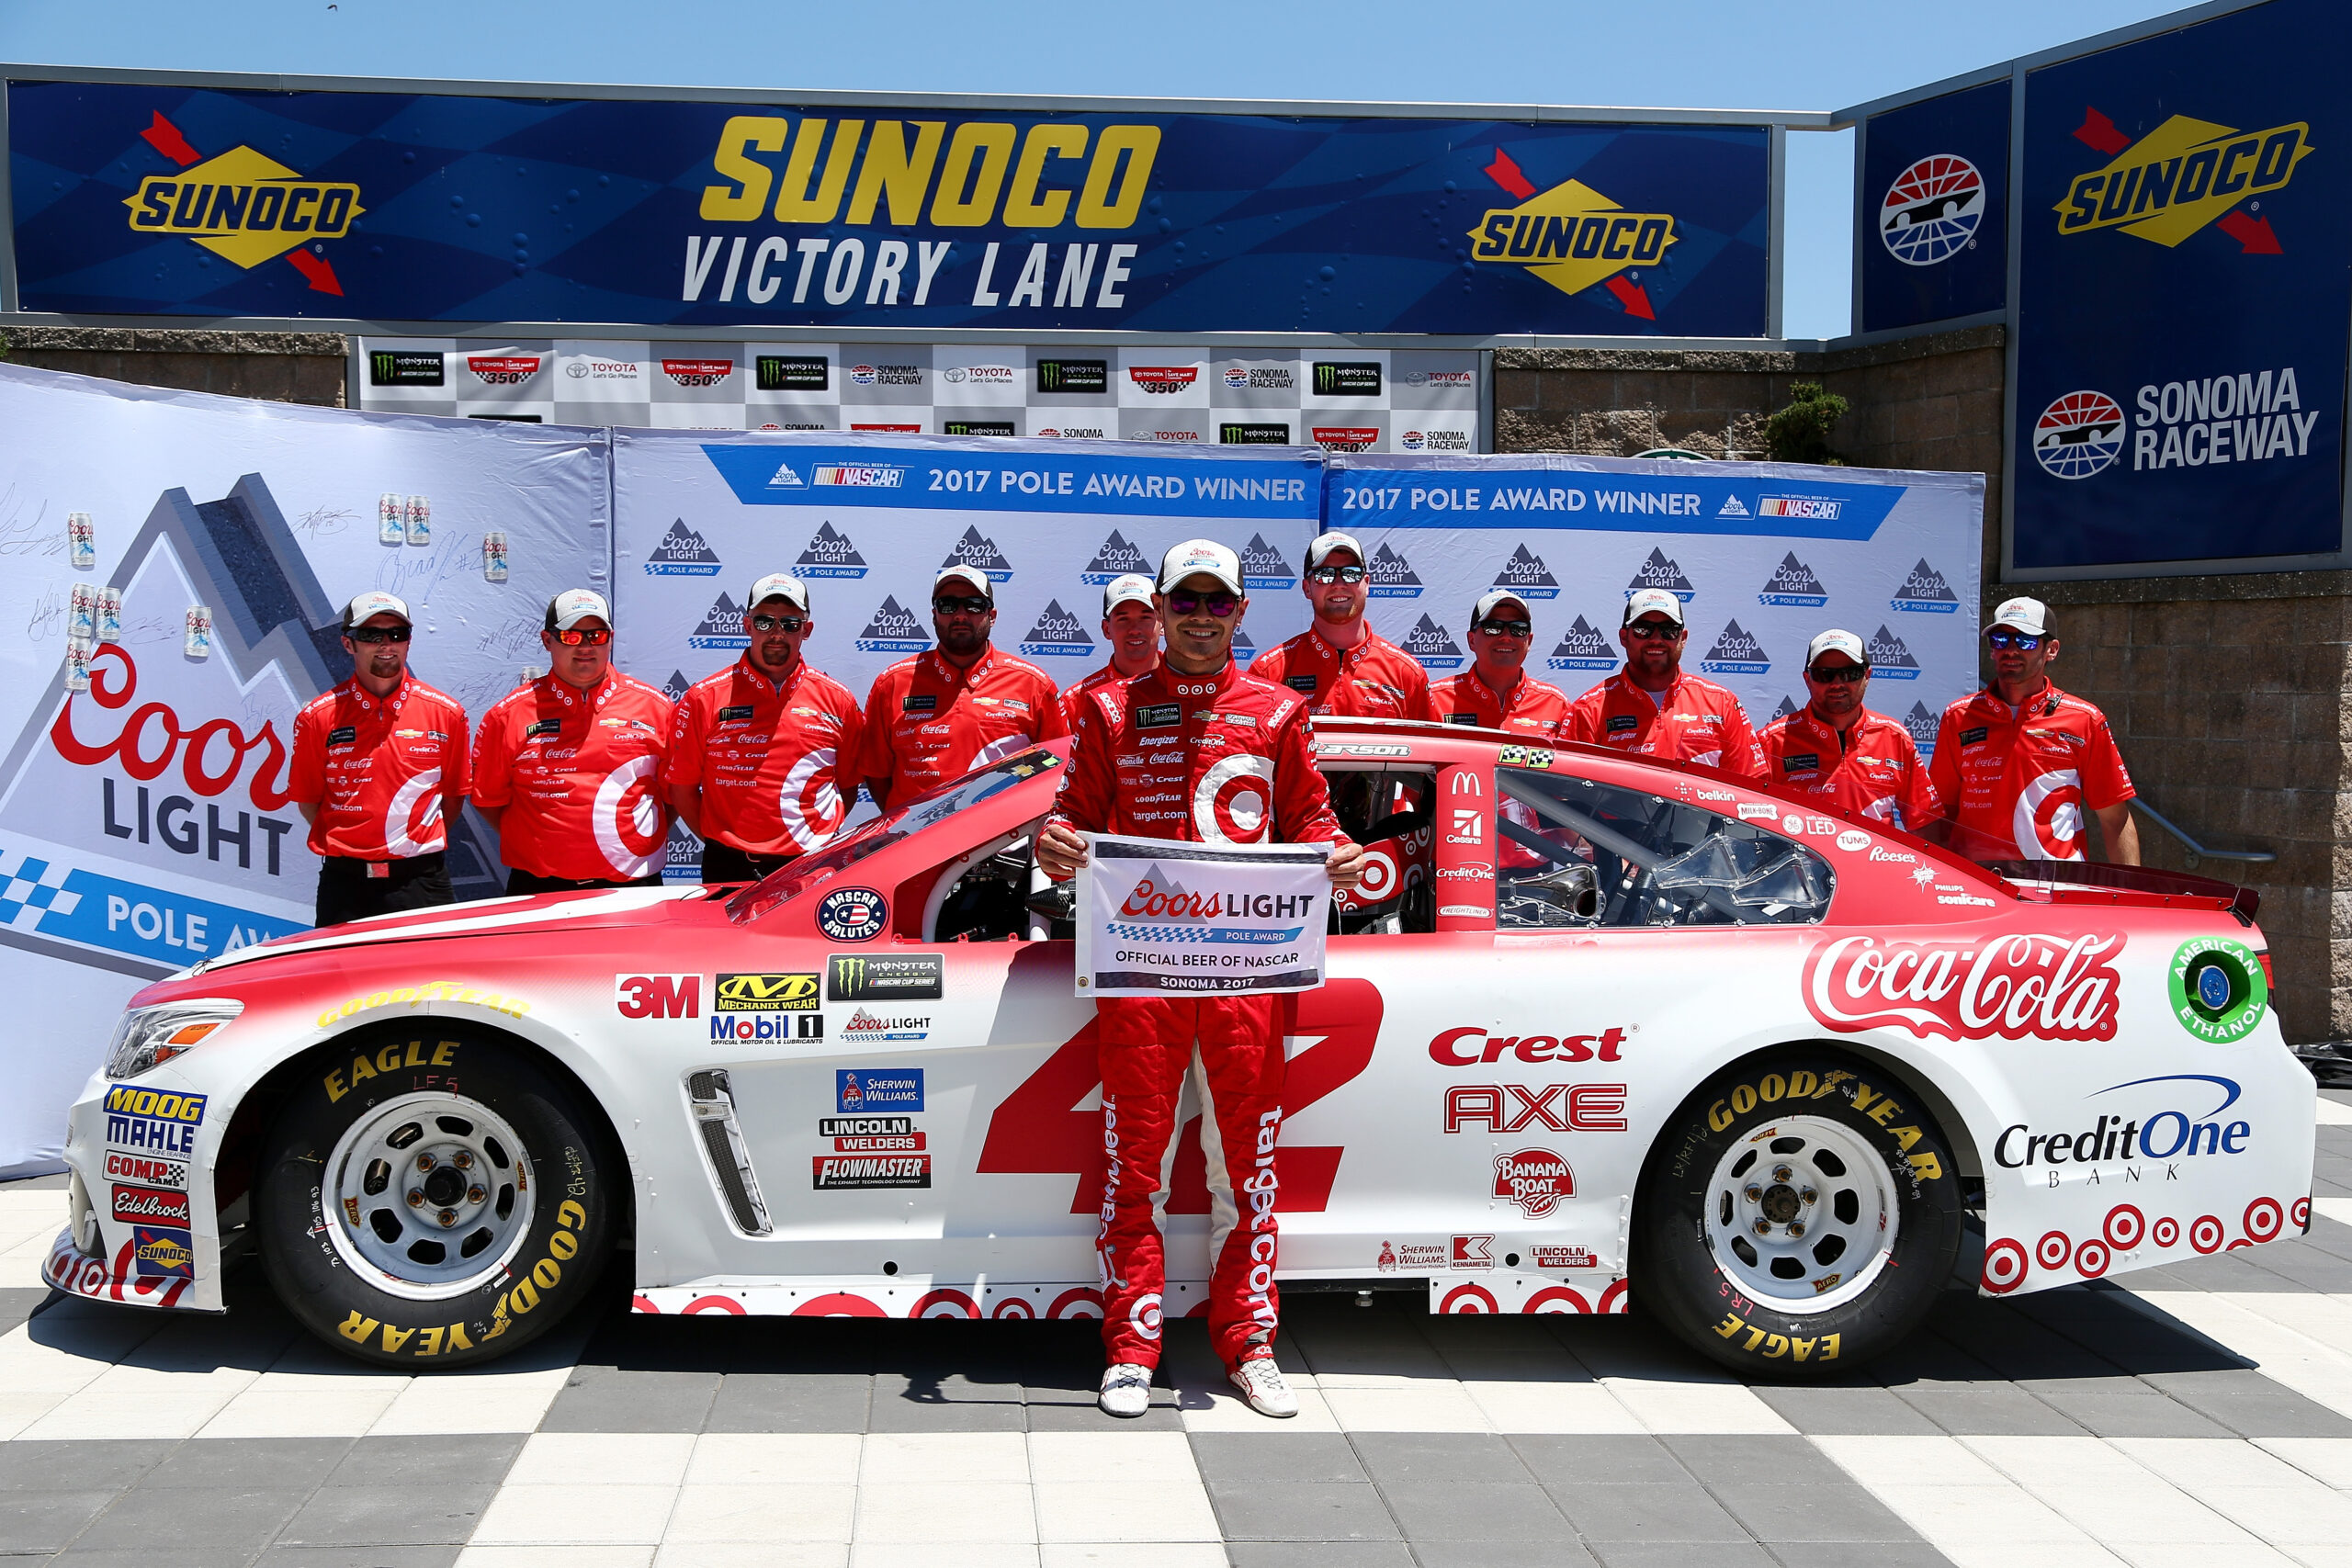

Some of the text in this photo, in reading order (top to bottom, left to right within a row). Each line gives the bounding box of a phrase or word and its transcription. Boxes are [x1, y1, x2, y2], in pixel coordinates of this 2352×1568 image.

[698, 116, 1162, 229] SUNOCO
[2064, 130, 2301, 229] SUNOCO
[135, 181, 353, 233] SUNOCO
[1477, 214, 1666, 263] SUNOCO
[682, 235, 1138, 309] VICTORY LANE
[591, 363, 637, 373] TOYOTA
[877, 365, 919, 376] SONOMA
[968, 367, 1012, 377] TOYOTA
[1250, 368, 1290, 378] SONOMA
[1337, 368, 1378, 377] MONSTER
[1428, 372, 1471, 381] TOYOTA
[487, 372, 519, 384] 350
[877, 375, 922, 385] RACEWAY
[1250, 378, 1295, 389] RACEWAY
[1148, 381, 1179, 393] 350
[2135, 367, 2301, 428] SONOMA
[1427, 431, 1466, 441] SONOMA
[2133, 410, 2319, 470] RACEWAY
[1427, 441, 1470, 450] RACEWAY
[842, 468, 899, 486] NASCAR
[928, 468, 1306, 502] 2017 POLE AWARD WINNER
[1342, 487, 1702, 516] 2017 POLE AWARD WINNER
[1787, 501, 1837, 518] NASCAR
[658, 532, 709, 551] Coors
[806, 535, 856, 554] Coors
[667, 550, 700, 560] LIGHT
[815, 553, 847, 562] LIGHT
[668, 566, 686, 574] POLE
[1771, 563, 1817, 583] Coors
[1779, 581, 1809, 592] LIGHT
[1797, 598, 1820, 606] AWARD
[1098, 692, 1121, 724] sparco
[1268, 699, 1295, 728] sparco
[50, 643, 290, 812] Coor
[1139, 736, 1178, 747] Energizer
[716, 777, 757, 787] target.com
[1697, 789, 1736, 802] belkin
[1133, 810, 1188, 822] target.com
[103, 777, 293, 876] LIGHT
[1806, 821, 1837, 835] LED
[1446, 834, 1482, 845] Cessna
[1840, 836, 1869, 845] TUMS
[1934, 884, 1964, 892] PHILIPS
[826, 890, 878, 910] NASCAR
[1120, 879, 1315, 919] Coors LIGHT
[1937, 893, 1996, 908] sonicare
[1442, 907, 1488, 916] FREIGHTLINER
[107, 894, 209, 953] POLE
[823, 919, 880, 939] SALUTES
[1226, 931, 1286, 942] POLE AWARD
[868, 961, 937, 972] MONSTER
[1115, 950, 1299, 967] OFFICIAL BEER OF NASCAR
[2173, 939, 2258, 982] AMERICAN
[1159, 976, 1255, 989] SONOMA 2017
[1810, 933, 2118, 1032] Coca-Cola
[617, 976, 700, 1019] 3M
[718, 998, 817, 1010] MECHANIX WEAR
[710, 1014, 788, 1039] Mobil
[846, 1013, 931, 1031] Coors LIGHT
[2179, 1000, 2262, 1039] ETHANOL
[1428, 1026, 1627, 1066] Crest
[322, 1040, 461, 1103] EAGLE
[866, 1078, 916, 1090] SHERWIN
[106, 1087, 204, 1122] MOOG
[1443, 1083, 1628, 1134] AXE
[107, 1114, 195, 1155] MAHLE
[823, 1119, 907, 1135] LINCOLN
[842, 1137, 916, 1150] WELDERS
[1993, 1111, 2251, 1168] CreditOne
[146, 1148, 167, 1156] ENGINE
[107, 1155, 168, 1179] COMP
[819, 1158, 922, 1186] FLOWMASTER
[1497, 1157, 1567, 1181] BANANA
[2048, 1162, 2180, 1189] BANK
[147, 1176, 180, 1188] CAMS
[1510, 1178, 1557, 1200] BOAT
[114, 1191, 189, 1222] Edelbrock
[139, 1246, 192, 1263] SUNOCO
[1399, 1244, 1445, 1255] SHERWIN
[1532, 1247, 1586, 1257] LINCOLN
[1543, 1258, 1590, 1267] WELDERS
[1816, 1275, 1838, 1291] AERO
[1712, 1312, 1841, 1362] EAGLE
